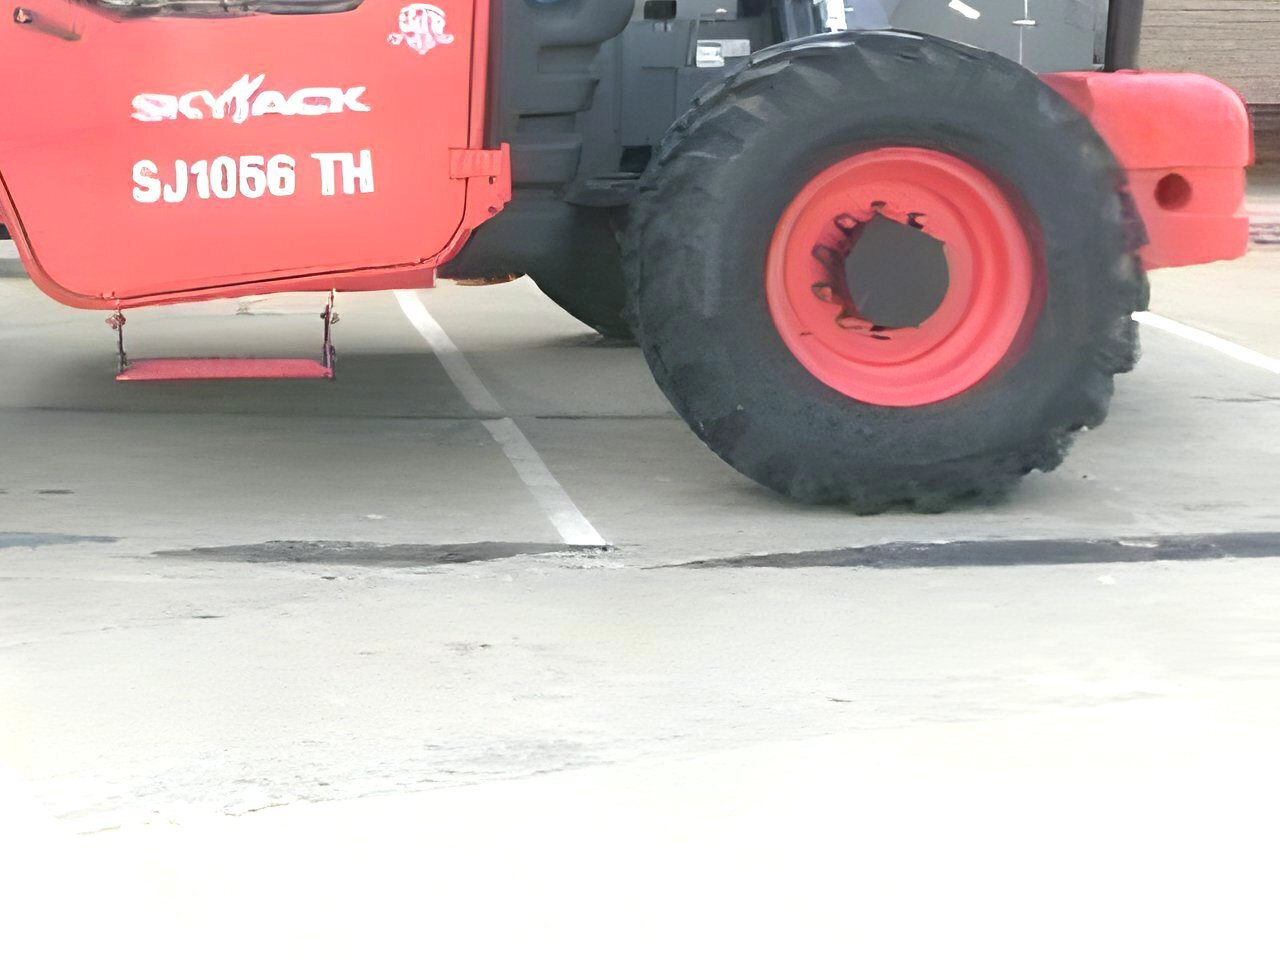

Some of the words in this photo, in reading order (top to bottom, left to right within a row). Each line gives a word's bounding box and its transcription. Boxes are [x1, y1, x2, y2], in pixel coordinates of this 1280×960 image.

[130, 73, 372, 124] SKYJACK
[131, 153, 297, 204] SJ1056
[309, 149, 375, 196] TH
